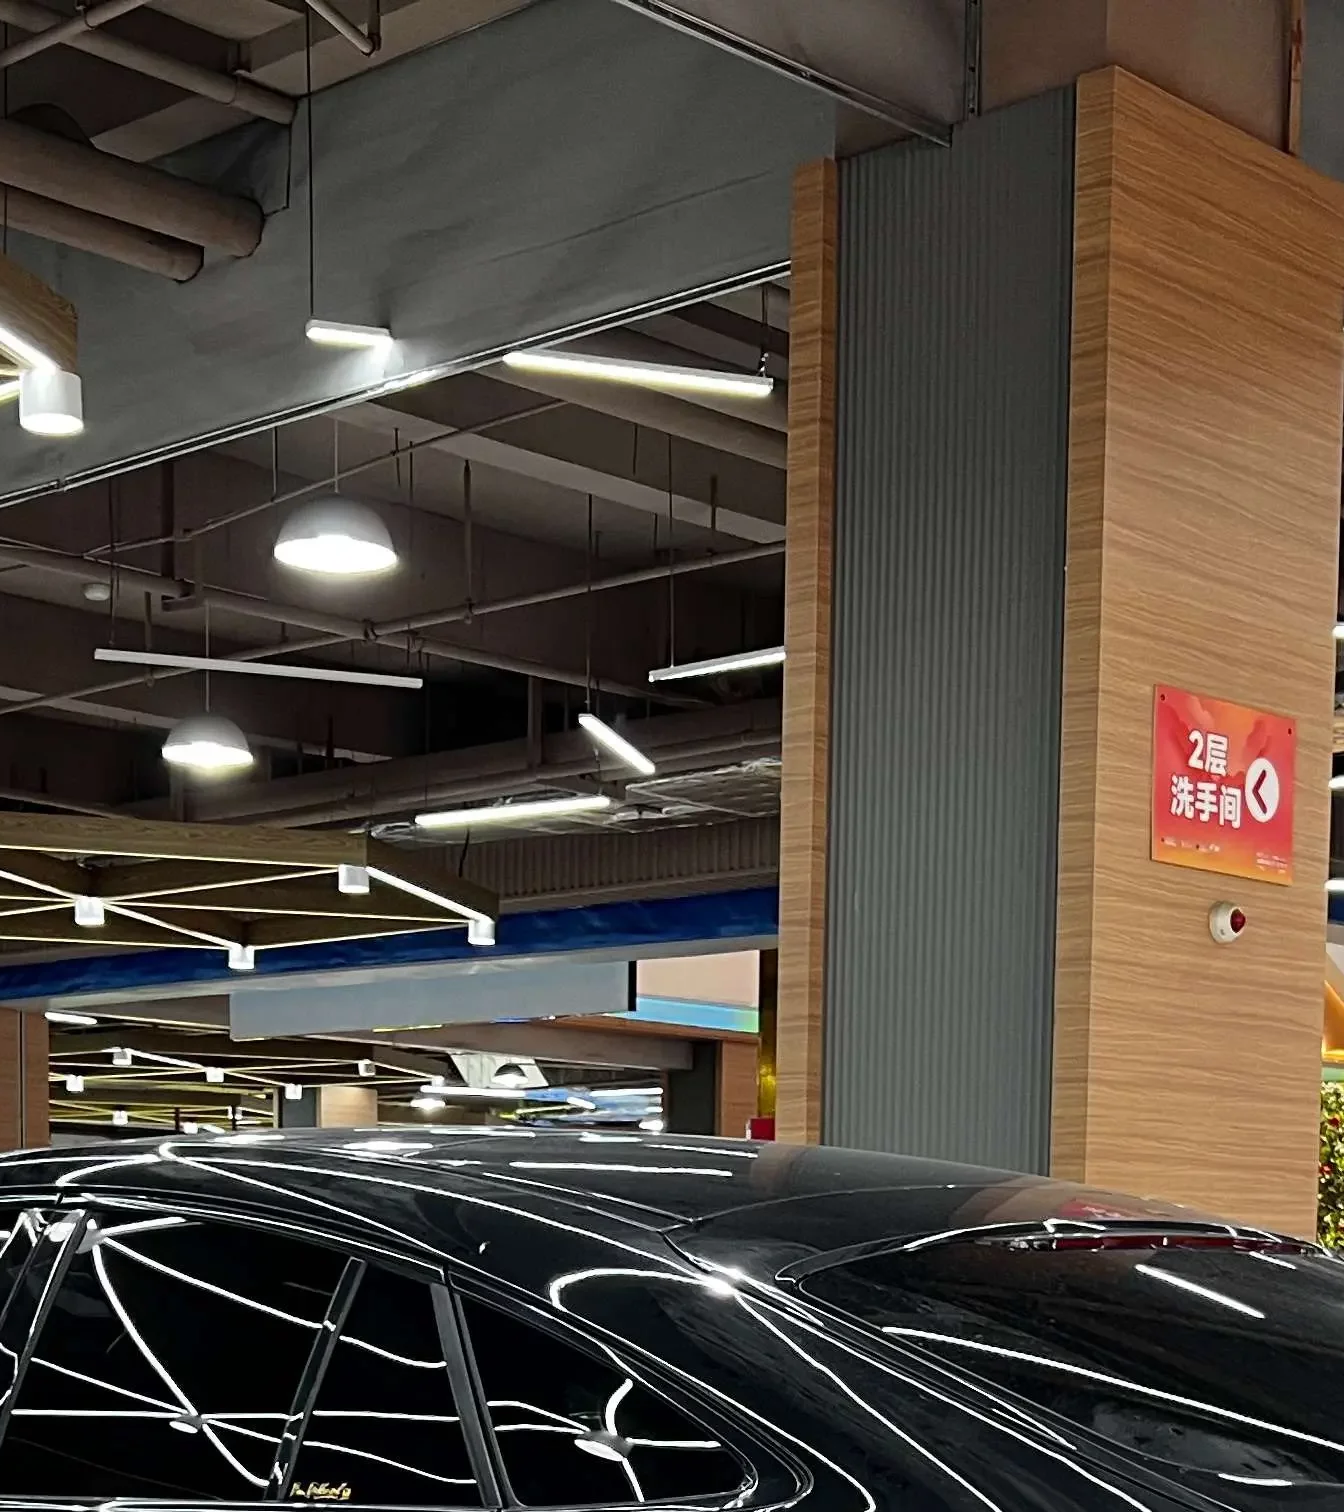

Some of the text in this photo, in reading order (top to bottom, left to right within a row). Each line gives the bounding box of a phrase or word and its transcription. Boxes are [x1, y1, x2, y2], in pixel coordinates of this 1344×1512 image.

[1187, 729, 1229, 776] 2层
[1170, 774, 1242, 829] 洗手间
